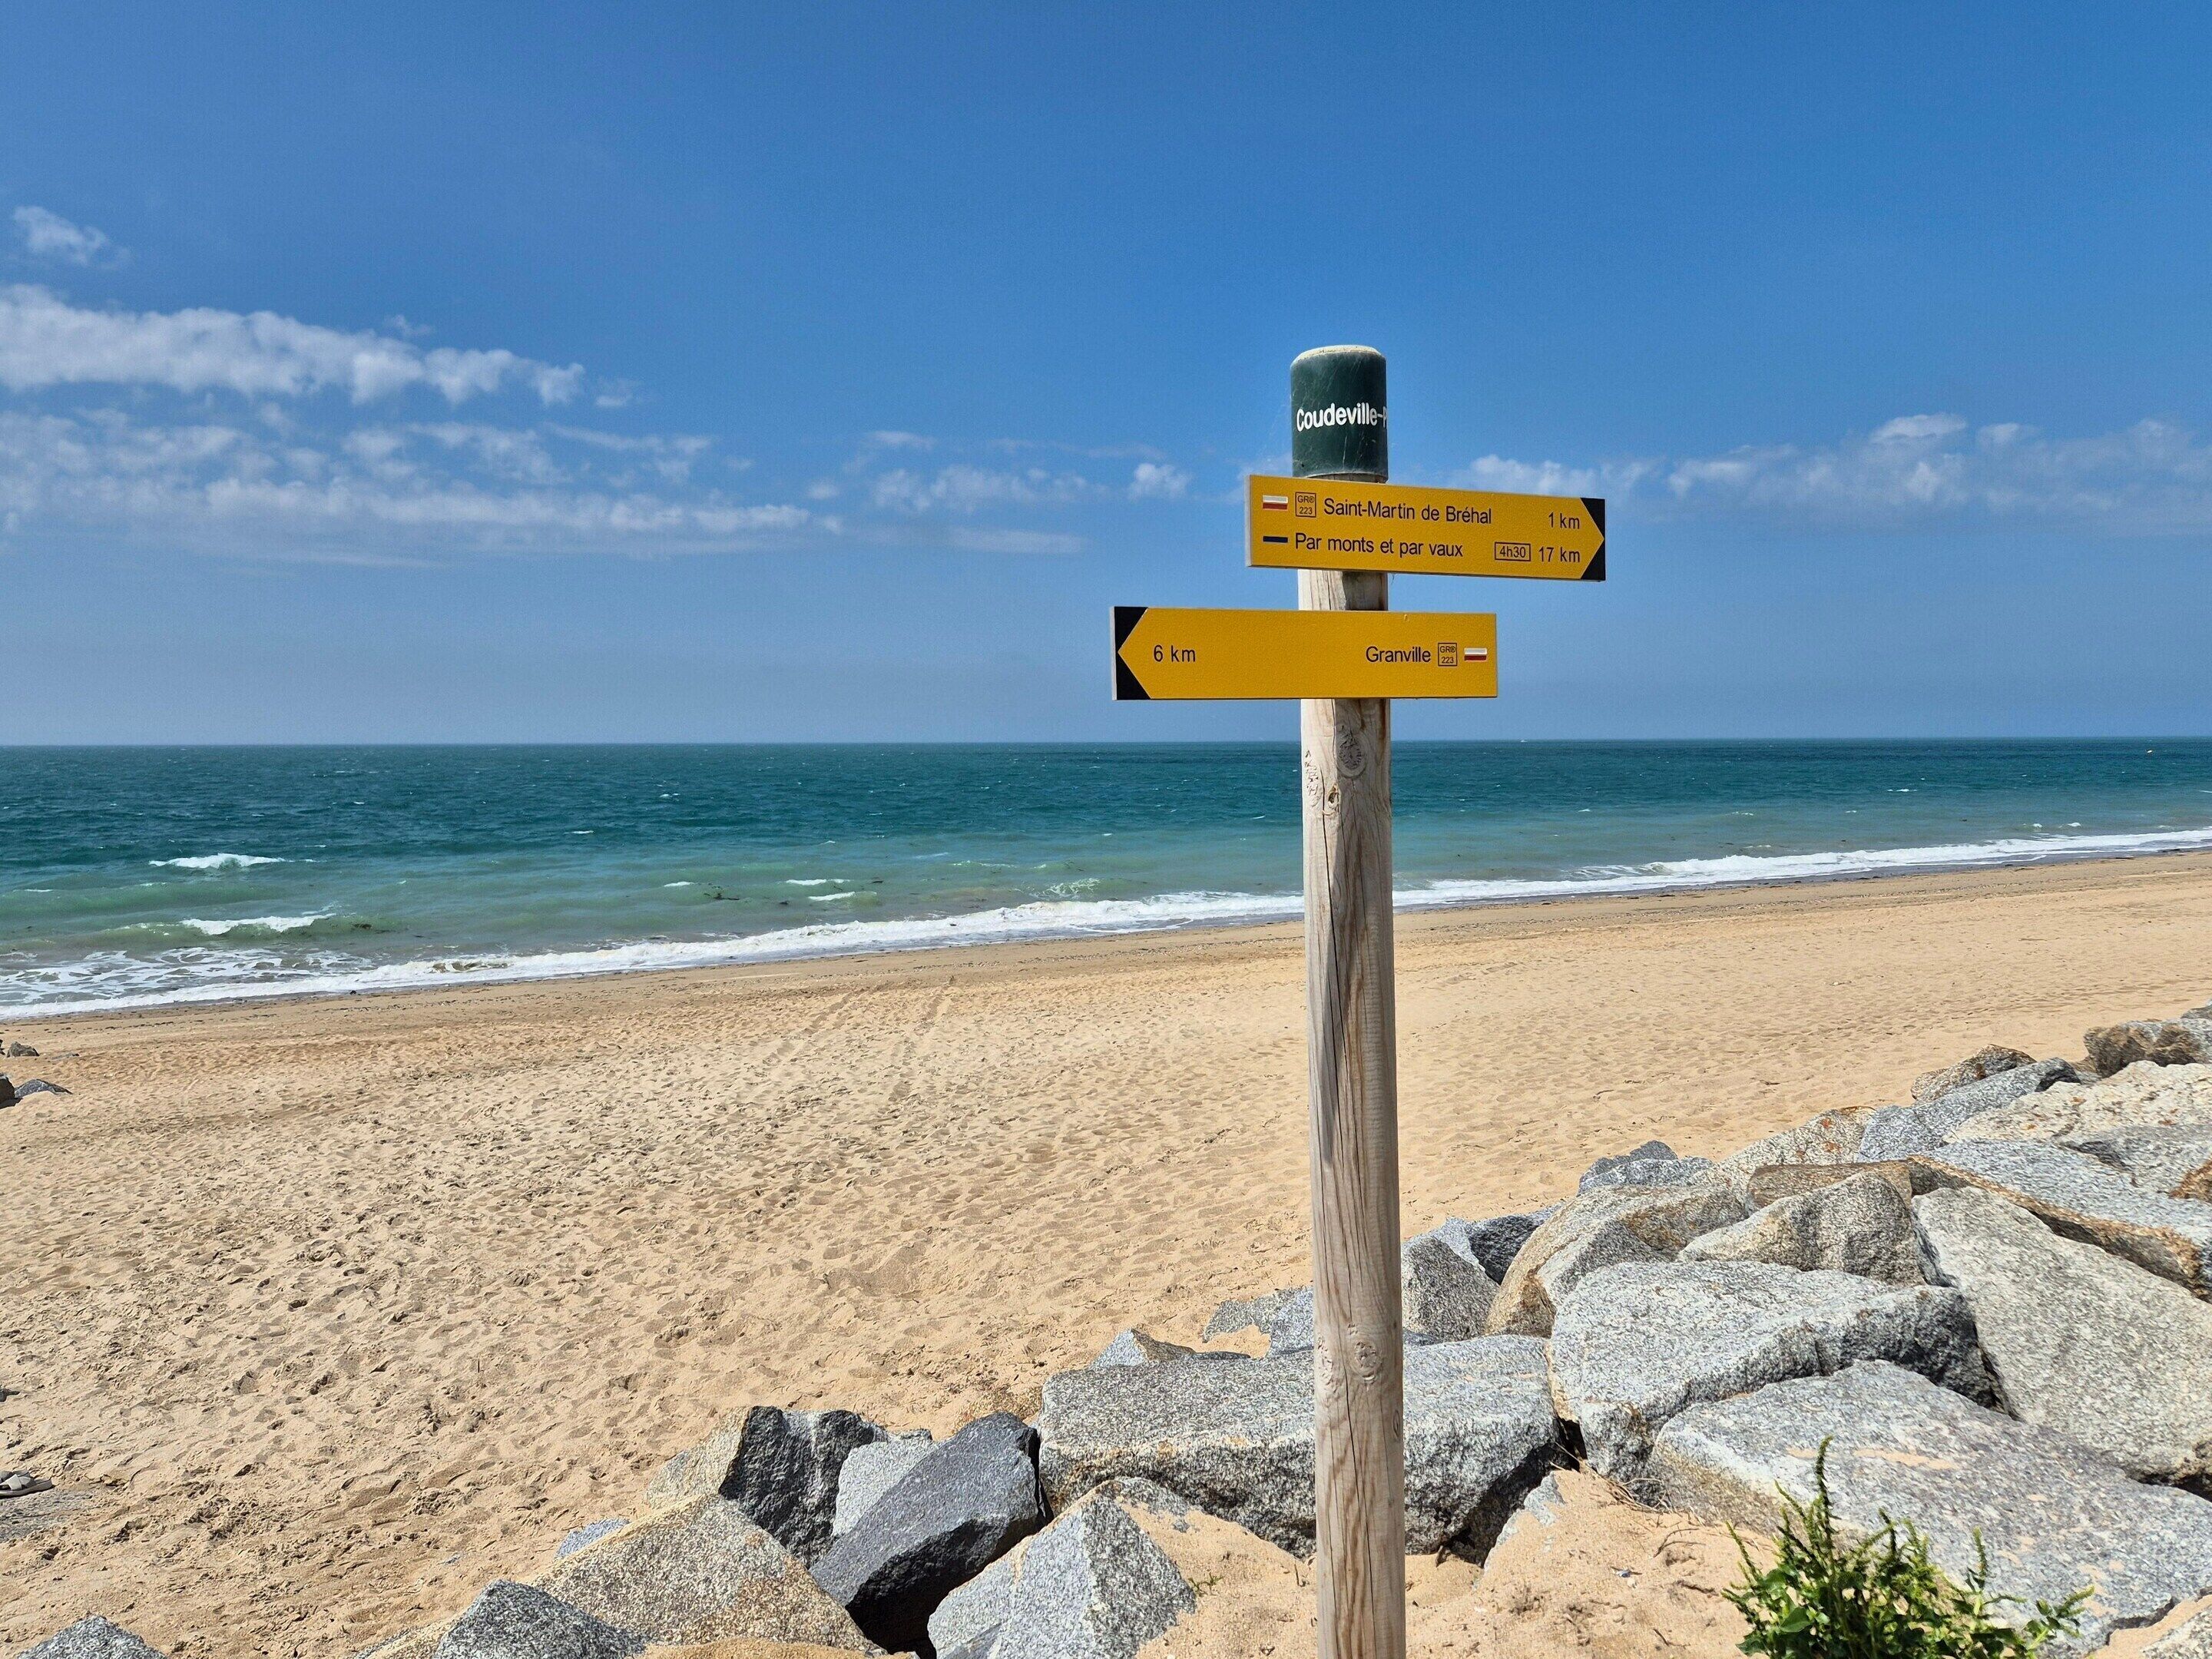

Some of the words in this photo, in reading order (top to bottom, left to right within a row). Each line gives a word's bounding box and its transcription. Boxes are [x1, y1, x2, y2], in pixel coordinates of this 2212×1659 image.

[1299, 506, 1313, 515] 223
[1323, 498, 1415, 520] Saint-Martin
[1421, 505, 1440, 521] de
[1445, 505, 1492, 525] Bréhal
[1548, 512, 1554, 528] 1
[1559, 512, 1580, 530] km
[1295, 532, 1322, 550] Par
[1327, 536, 1375, 553] monts
[1379, 538, 1395, 555] et
[1399, 541, 1424, 558] par
[1429, 543, 1463, 558] vaux
[1499, 546, 1526, 558] 4h30
[1538, 546, 1555, 562] 17
[1560, 546, 1581, 563] km
[1153, 644, 1164, 662] 6
[1171, 644, 1196, 662] km
[1366, 646, 1432, 663] Granville
[1442, 656, 1454, 664] 223
